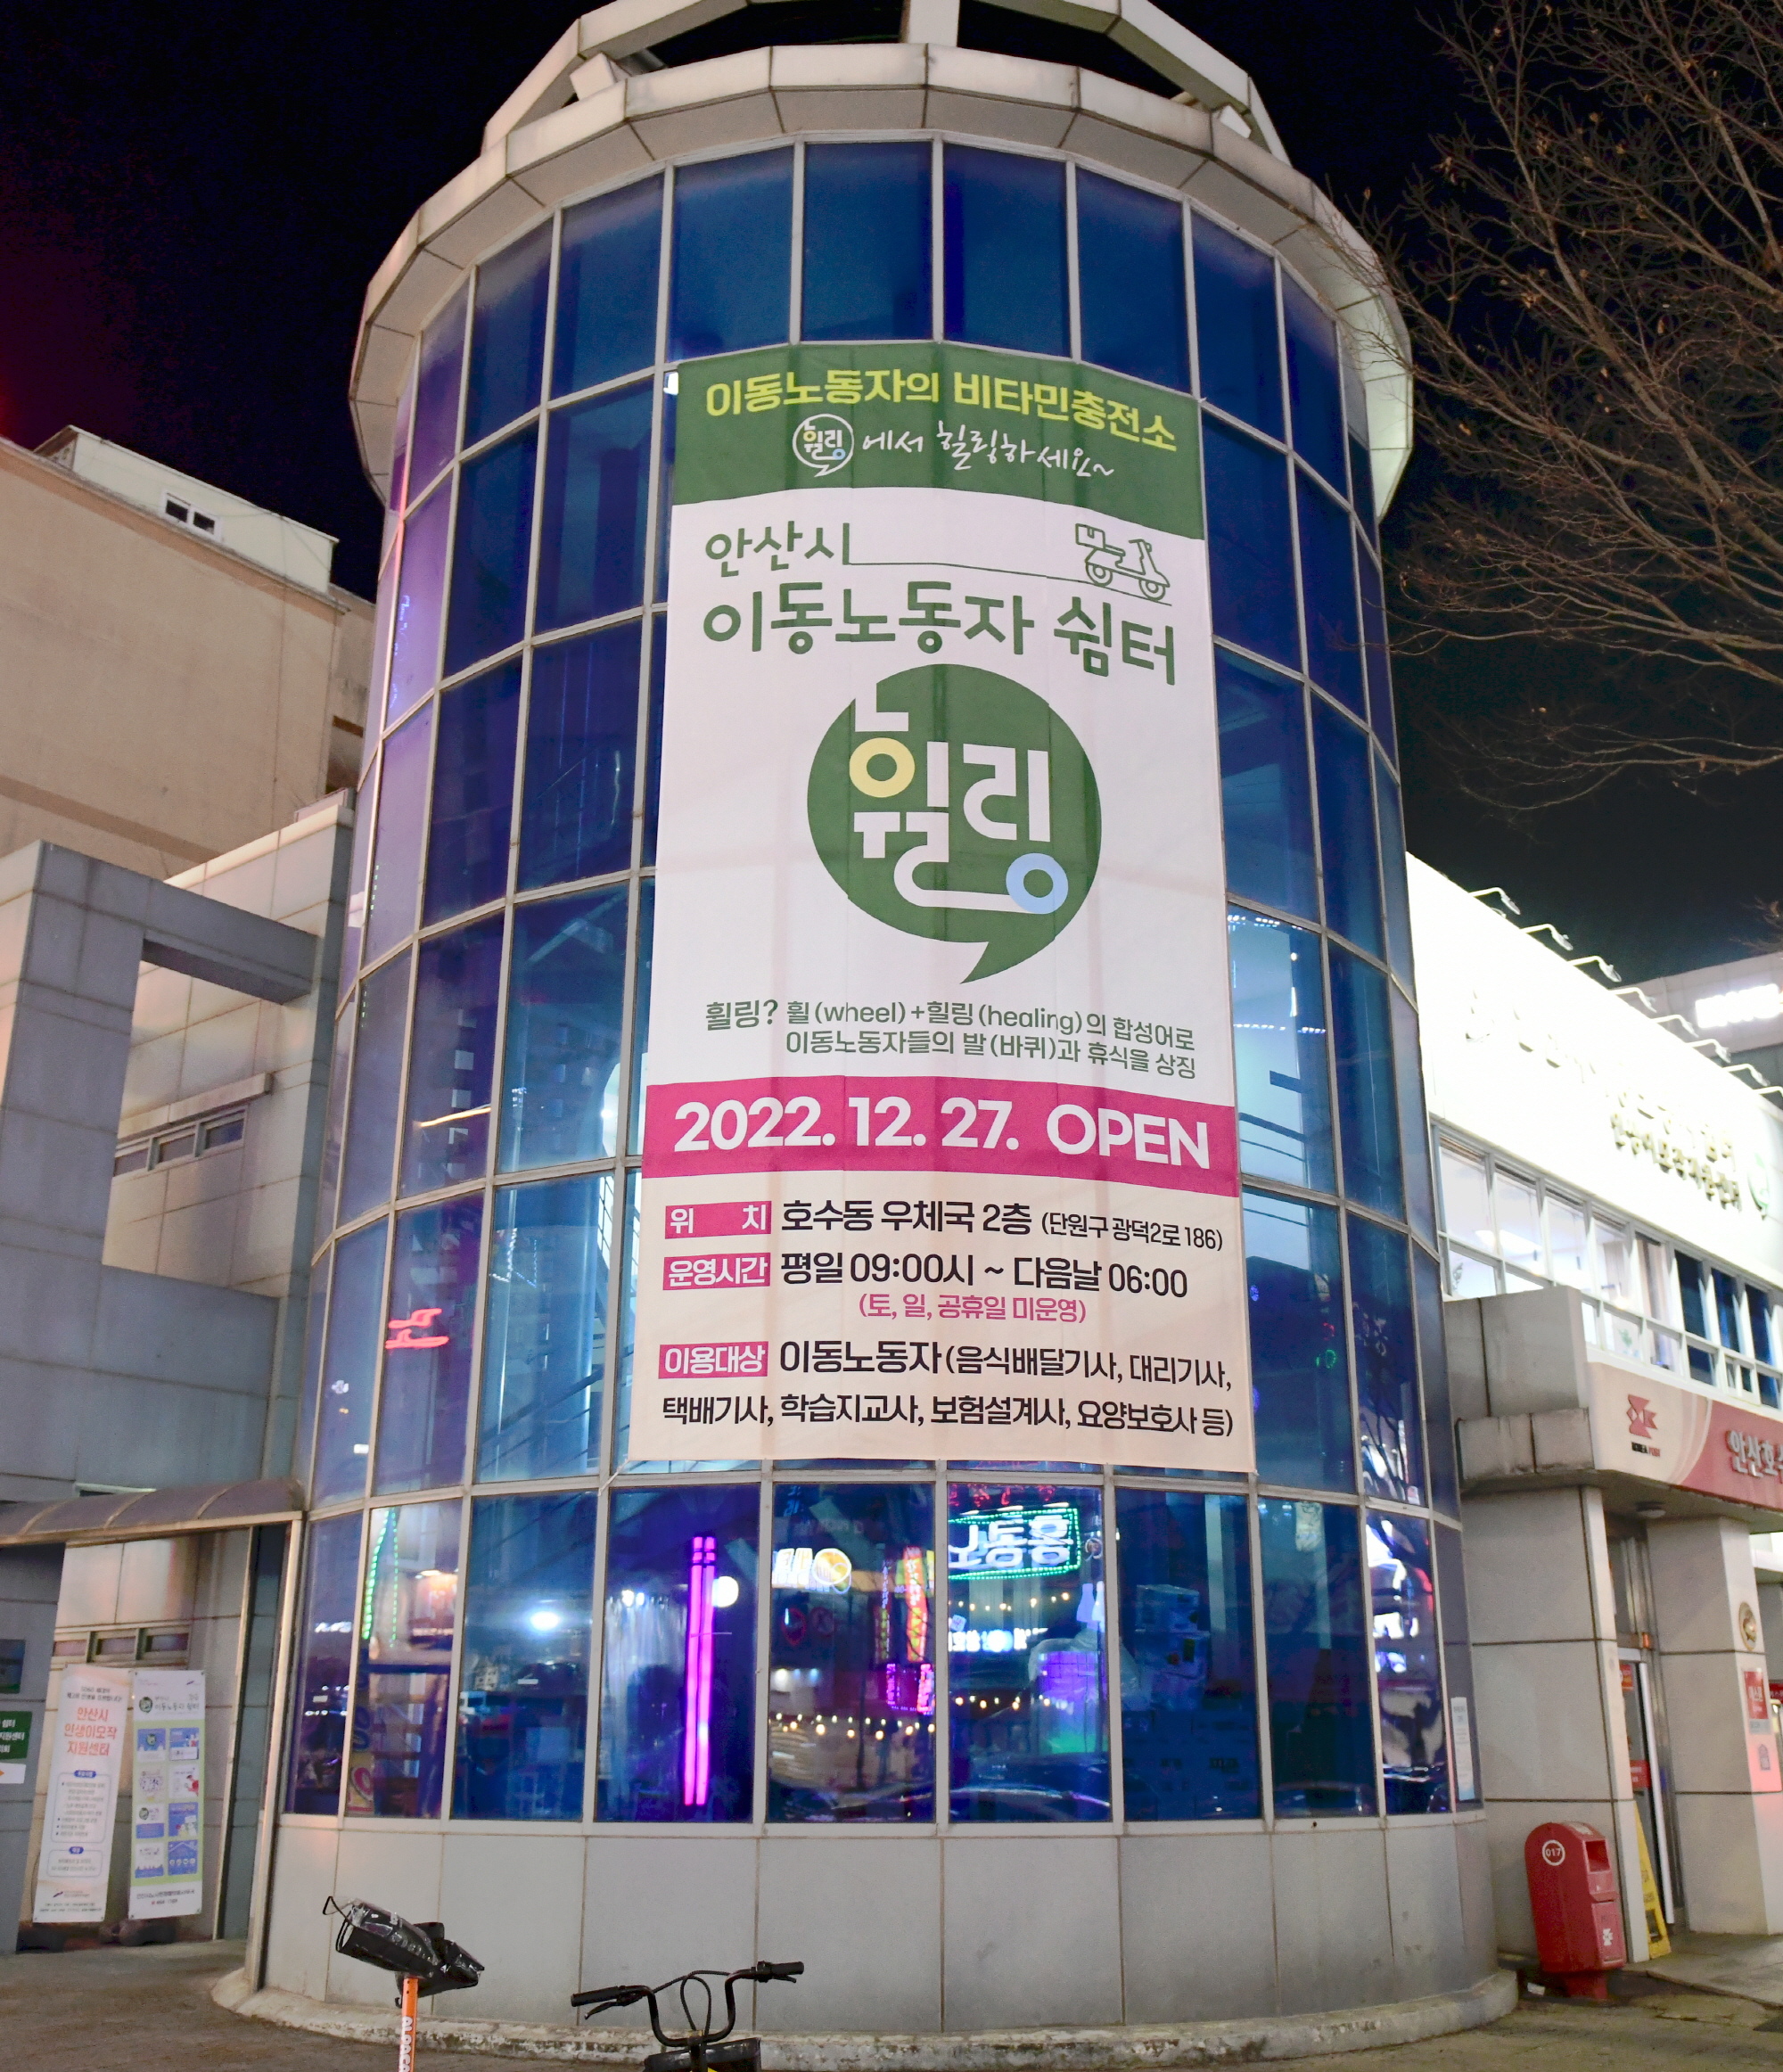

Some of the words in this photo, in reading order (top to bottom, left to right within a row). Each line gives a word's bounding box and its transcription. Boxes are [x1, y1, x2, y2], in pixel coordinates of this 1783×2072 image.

[706, 369, 939, 417] 이동노동자의
[953, 372, 1178, 452] 비타민충전소
[862, 432, 924, 454] 에서
[704, 520, 851, 578] 안산시
[703, 580, 1034, 656] 이동노동자
[1053, 596, 1176, 686] 쉼터
[705, 999, 778, 1031] 휠링?
[1113, 1016, 1195, 1051] 합성어로
[785, 1031, 955, 1055] 이동노동자들의
[1088, 1041, 1150, 1073] 휴식을
[1155, 1053, 1196, 1080] 상징
[673, 1096, 834, 1153] 2022.
[848, 1097, 926, 1148] 12.
[941, 1098, 1020, 1151] 27.
[1047, 1104, 1210, 1170] OPEN
[670, 1208, 695, 1234] 위
[743, 1205, 768, 1230] 치
[782, 1199, 873, 1233] 호수동
[882, 1200, 974, 1233] 우체국
[983, 1203, 1032, 1235] 2층
[1041, 1211, 1108, 1239] (단원구
[1112, 1217, 1180, 1247] 광덕2로
[1185, 1225, 1223, 1252] 186)
[668, 1258, 768, 1287] 운영시간
[781, 1252, 843, 1285] 평일
[850, 1253, 975, 1285] 09:00시
[1013, 1255, 1102, 1293] 다음날
[1108, 1264, 1188, 1298] 06:00
[939, 1295, 1007, 1320] 공휴일
[1014, 1296, 1087, 1324] 미운영)
[664, 1345, 765, 1375] 이용대상
[1130, 1353, 1233, 1392] 대리기사,
[661, 1396, 774, 1427] 택배기사,
[780, 1394, 924, 1427] 학습지교사,
[932, 1394, 1071, 1429] 보험설계사,
[1077, 1399, 1198, 1435] 요양보호사
[1203, 1406, 1234, 1436] 등)
[1726, 1430, 1783, 1481] 안산호
[1545, 1847, 1561, 1857] 017
